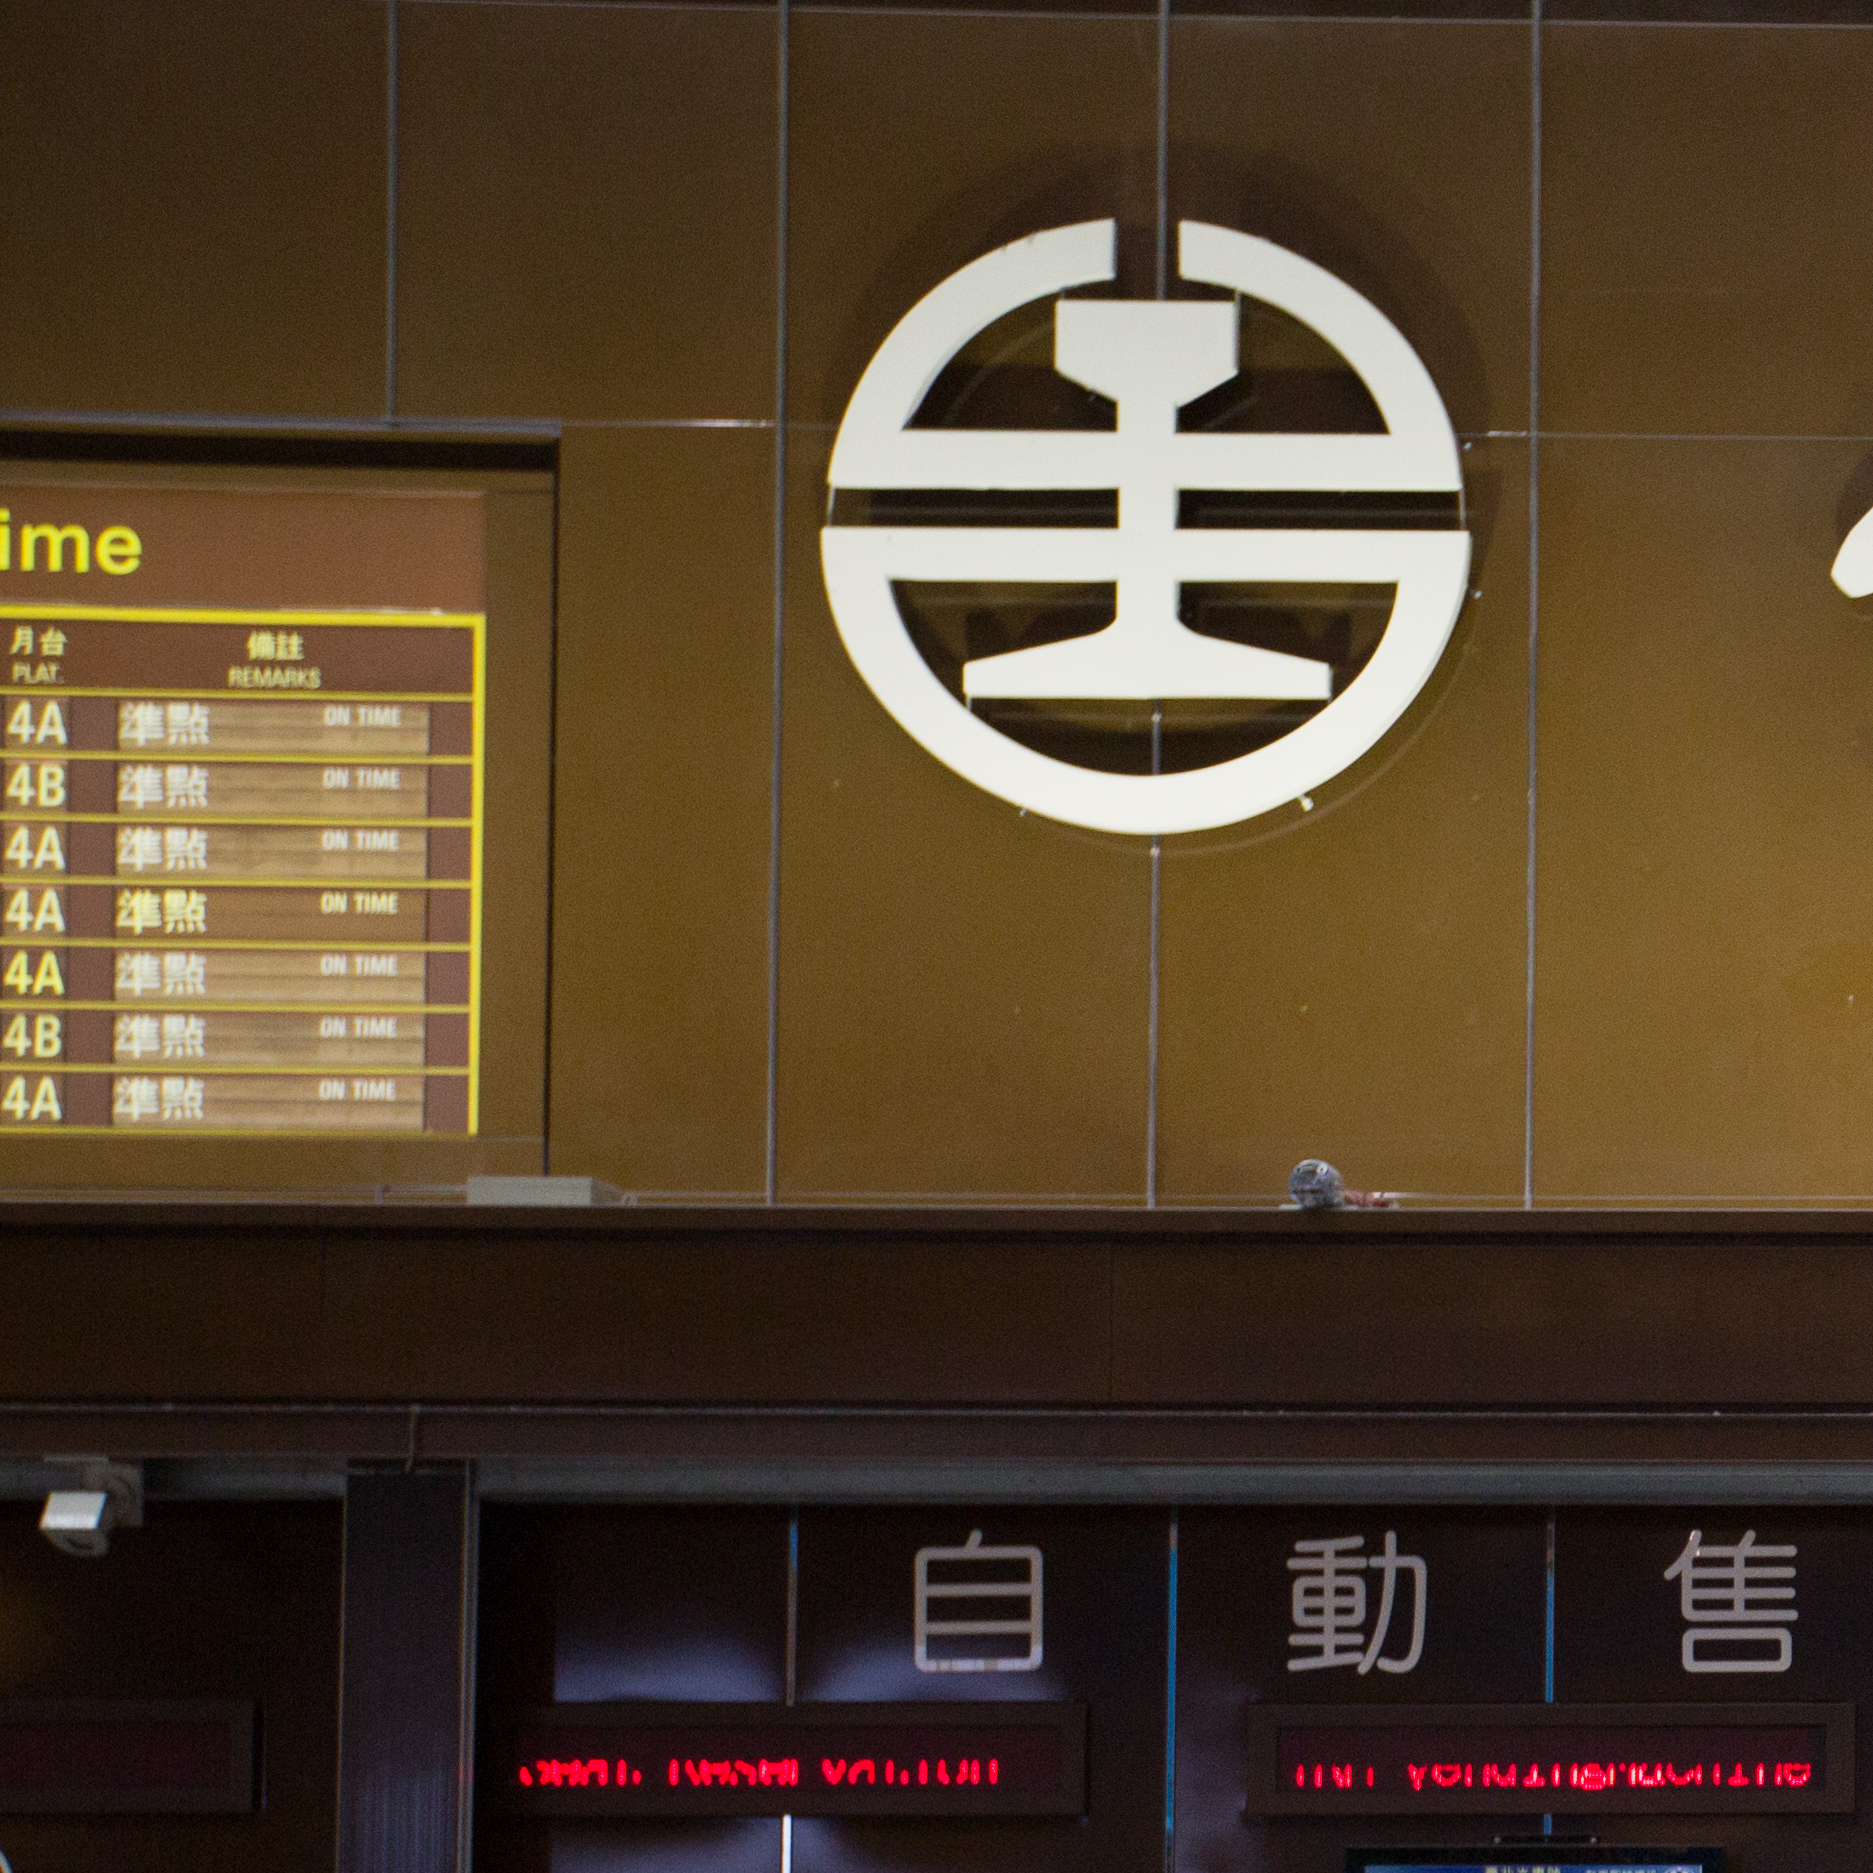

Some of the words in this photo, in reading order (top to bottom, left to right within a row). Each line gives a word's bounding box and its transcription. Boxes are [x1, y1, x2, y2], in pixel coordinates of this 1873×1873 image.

[9, 626, 68, 655] 月台
[247, 631, 305, 661] 備註
[228, 665, 322, 689] REMARKS
[7, 699, 68, 745] 4A
[118, 702, 210, 746] 準點
[323, 706, 350, 727] ON
[356, 706, 401, 727] TIME
[7, 765, 66, 807] 4B
[118, 765, 209, 808] 準點
[323, 768, 349, 789] ON
[355, 768, 400, 789] TIME
[5, 826, 66, 869] 4A
[118, 828, 208, 870] 準點
[322, 830, 348, 851] ON
[354, 830, 399, 851] TIME
[5, 890, 65, 933] 4A
[116, 890, 207, 933] 準點
[321, 893, 348, 914] ON
[354, 893, 398, 914] TIME
[4, 951, 65, 995] 4A
[116, 952, 206, 996] 準點
[320, 956, 347, 976] ON
[354, 956, 398, 976] TIME
[3, 1015, 62, 1058] 4B
[115, 1016, 206, 1058] 準點
[320, 1018, 347, 1038] ON
[353, 1018, 398, 1038] TIME
[2, 1078, 62, 1121] 4A
[114, 1079, 205, 1121] 準點
[319, 1080, 346, 1101] ON
[353, 1080, 397, 1101] TIME
